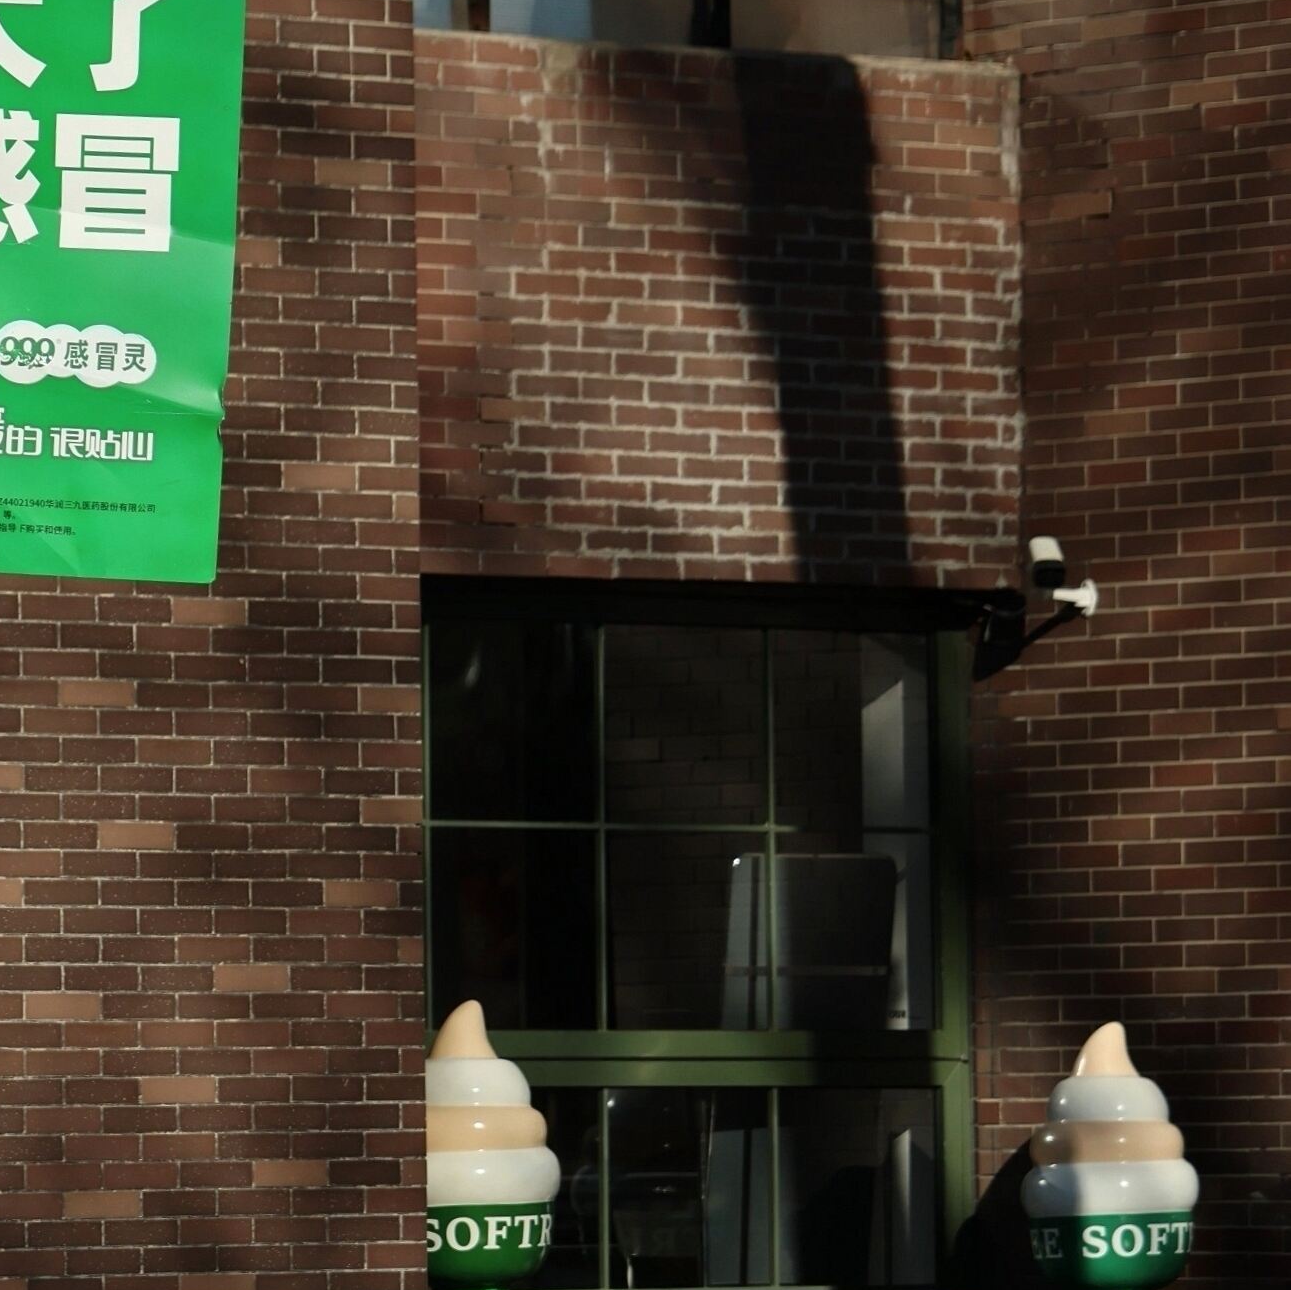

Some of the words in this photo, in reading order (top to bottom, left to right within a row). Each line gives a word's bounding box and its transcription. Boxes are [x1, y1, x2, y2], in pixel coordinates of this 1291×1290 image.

[63, 340, 148, 373] 感冒灵
[49, 427, 154, 461] 很贴心
[1081, 1221, 1194, 1260] SOFT
